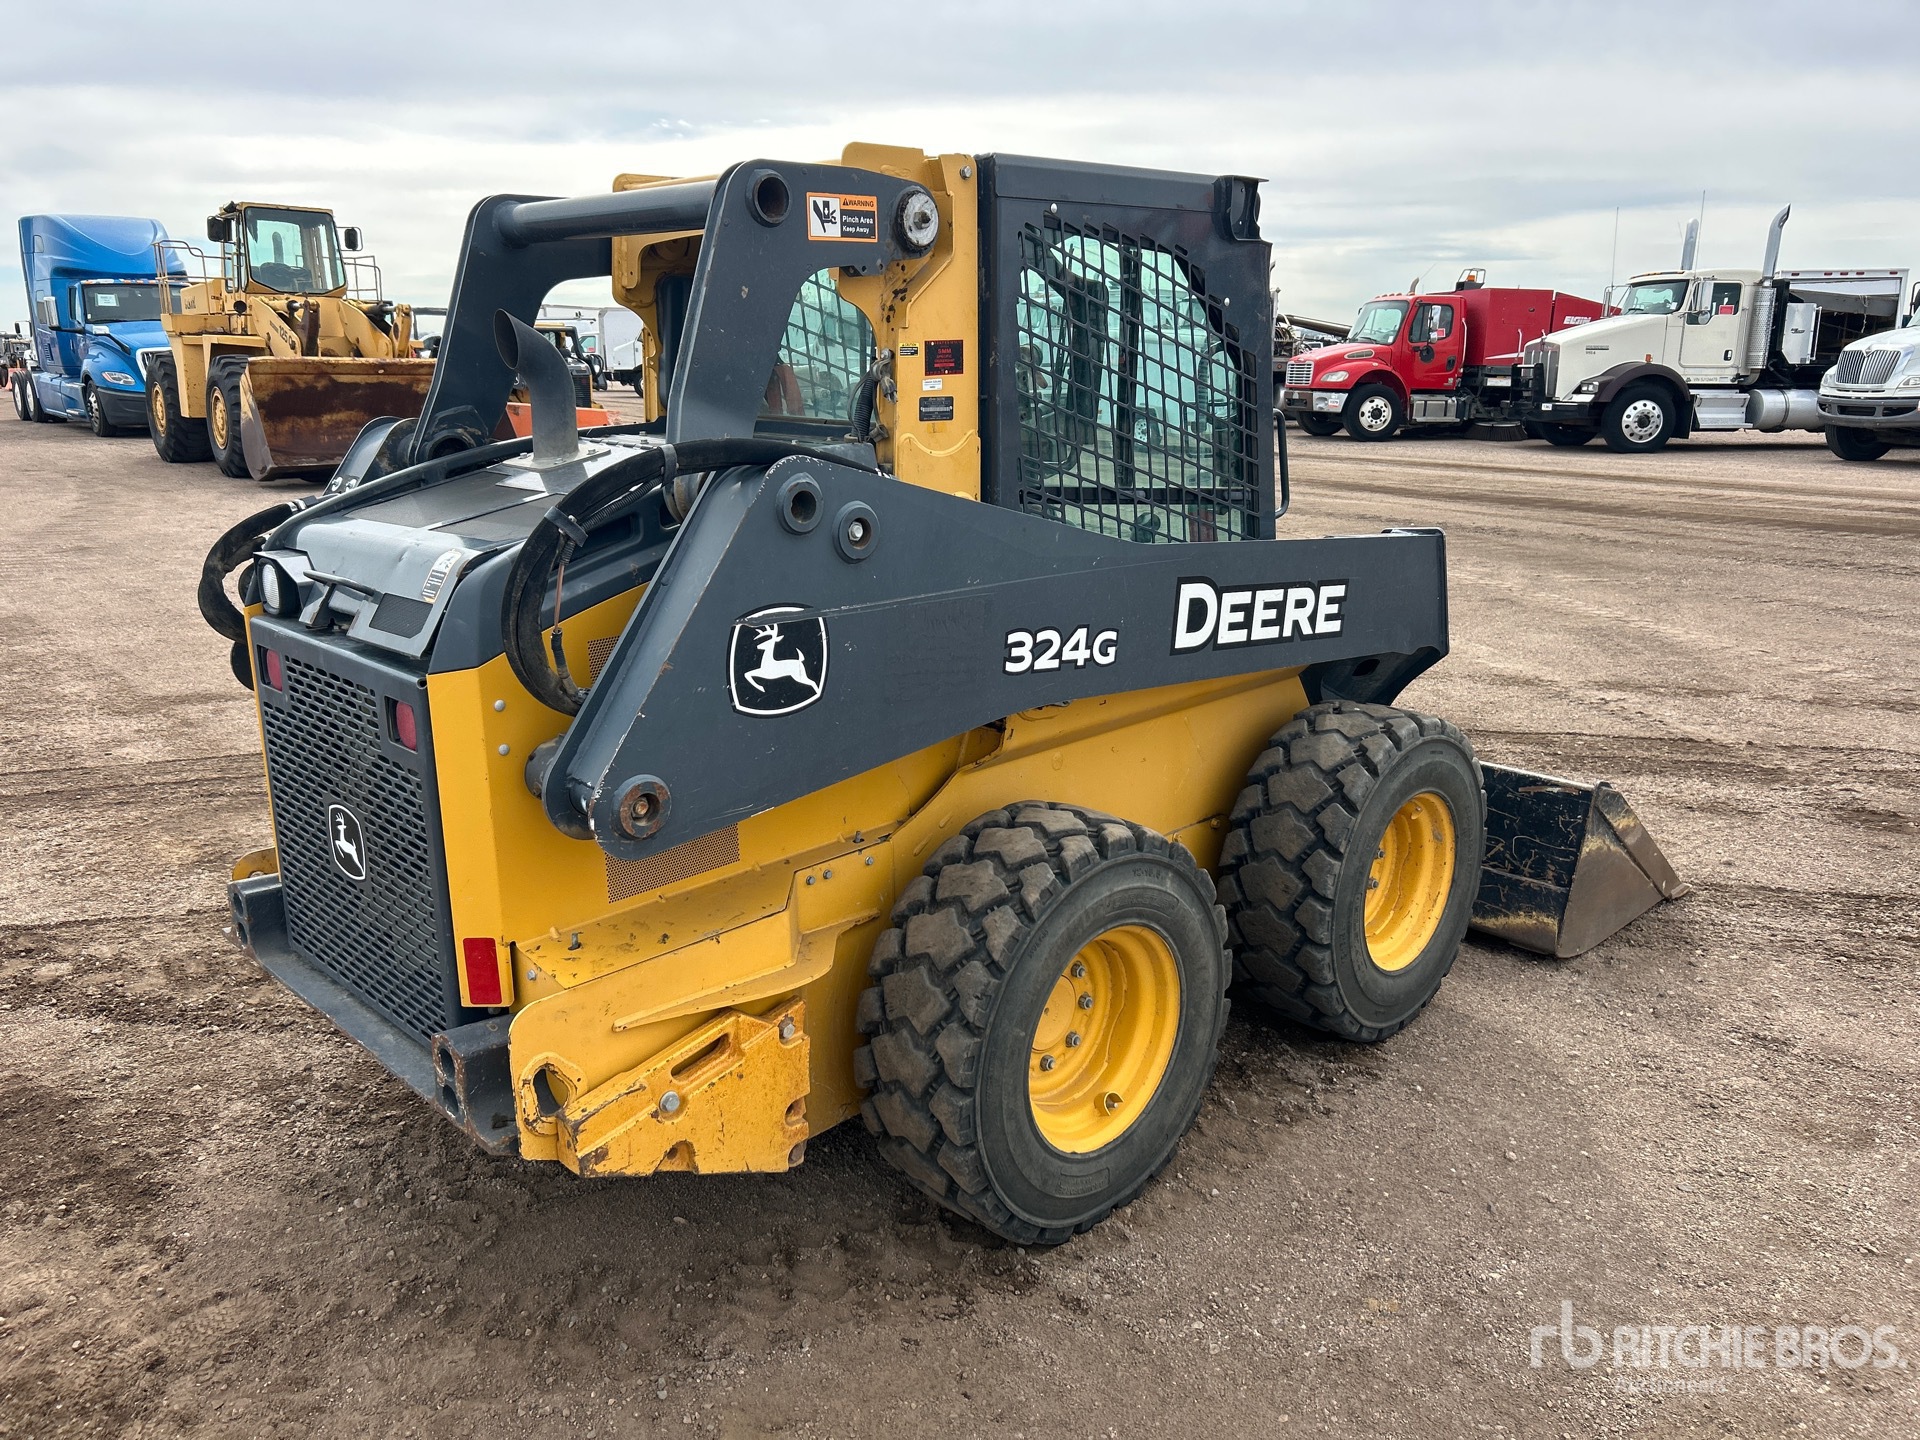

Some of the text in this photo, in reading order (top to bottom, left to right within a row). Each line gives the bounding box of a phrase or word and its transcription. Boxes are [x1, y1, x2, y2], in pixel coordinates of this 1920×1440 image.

[849, 200, 874, 208] WARNING
[842, 215, 874, 225] Pinch Area
[842, 225, 870, 234] Keep Away
[1563, 315, 1592, 325] ELGIN
[1172, 576, 1346, 651] DEERE
[1004, 627, 1118, 674] 324G
